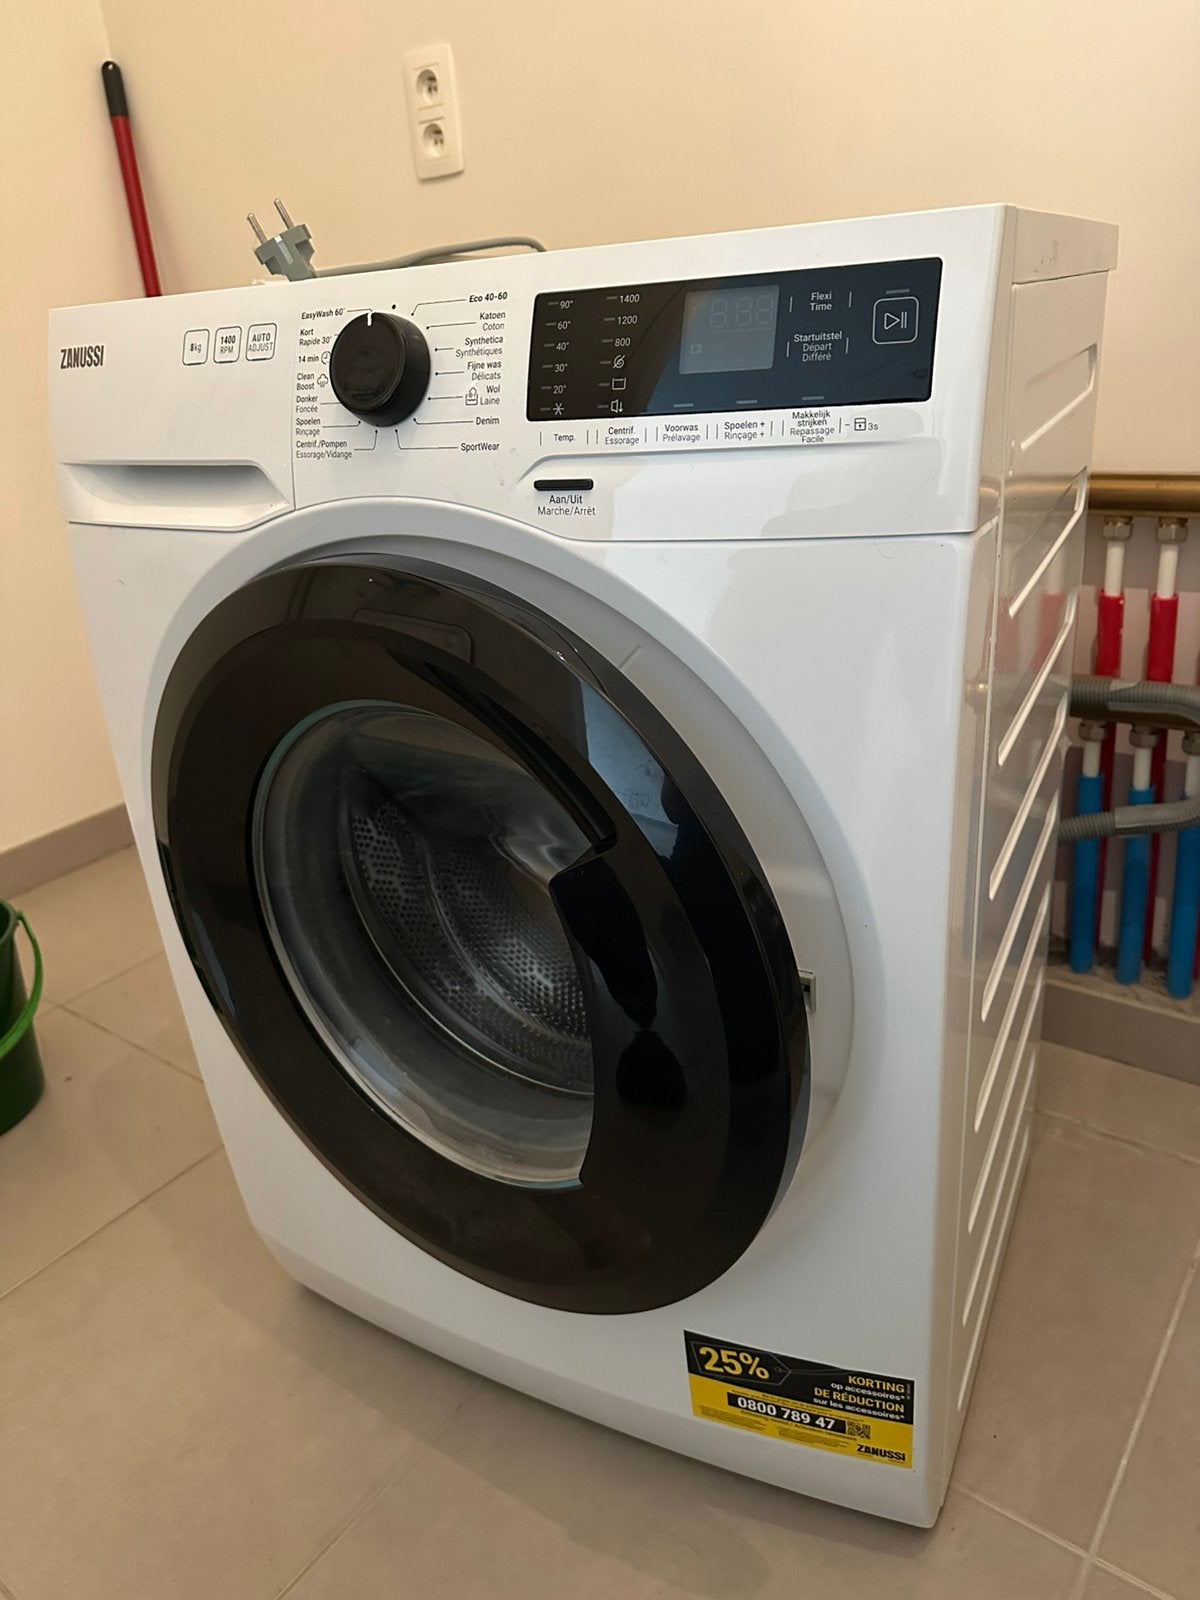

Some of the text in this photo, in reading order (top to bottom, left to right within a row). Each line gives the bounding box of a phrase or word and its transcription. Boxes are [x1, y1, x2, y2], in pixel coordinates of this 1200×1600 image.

[469, 292, 508, 303] Eco 40-60
[619, 294, 640, 303] 1400
[811, 290, 832, 300] Flexi
[560, 300, 574, 309] 90°
[810, 302, 832, 310] Time
[301, 310, 334, 320] EasyWash
[480, 312, 506, 320] Katoen
[617, 315, 638, 325] 1200
[482, 322, 504, 331] Coton
[557, 320, 571, 330] 60°
[220, 335, 236, 345] 1400
[252, 333, 271, 343] AUTO
[300, 337, 320, 346] Rapide
[464, 336, 504, 347] Synthetica
[794, 331, 842, 343] Startuitstel
[248, 342, 273, 352] ADJUST
[556, 342, 570, 350] 40°
[614, 338, 630, 347] 800
[802, 342, 832, 352] Départ
[190, 343, 202, 354] 8kg
[220, 345, 234, 354] RPM
[456, 348, 503, 359] Synthétiques
[60, 345, 105, 370] ZANUSSI
[802, 352, 832, 363] Différé
[467, 362, 486, 372] Fijne
[554, 364, 568, 372] 30°
[472, 372, 501, 380] Délicats
[553, 385, 566, 394] 20°
[480, 397, 500, 405] Laine
[792, 410, 830, 420] Makkelijk
[296, 418, 320, 426] Spoelen
[476, 416, 500, 425] Denim
[797, 418, 828, 427] strijken
[608, 426, 636, 436] Centrif.
[664, 424, 698, 432] Voorwas
[724, 422, 758, 431] Spoelen
[790, 426, 834, 436] Repassage
[868, 422, 879, 431] 3s
[296, 428, 320, 437] Rinçage
[724, 431, 758, 441] Rinçage
[554, 434, 576, 442] Temp.
[605, 436, 640, 446] Essorage
[662, 433, 700, 443] Prélavage
[802, 435, 824, 443] Facile
[296, 440, 347, 449] Centrif./Pompen
[460, 442, 500, 452] SportWear
[296, 450, 352, 460] Essorage/Vidange
[549, 494, 582, 504] Aan/Uit
[699, 1346, 770, 1380] 25%
[830, 1382, 843, 1390] op
[848, 1375, 905, 1393] KORTING
[813, 1398, 828, 1406] sur
[830, 1400, 844, 1409] les
[814, 1387, 830, 1398] DE
[832, 1390, 904, 1413] RÉDUCTION
[737, 1396, 776, 1416] 0800
[780, 1407, 811, 1424] 789
[815, 1416, 836, 1430] 47
[856, 1443, 906, 1462] ZANUSSI
